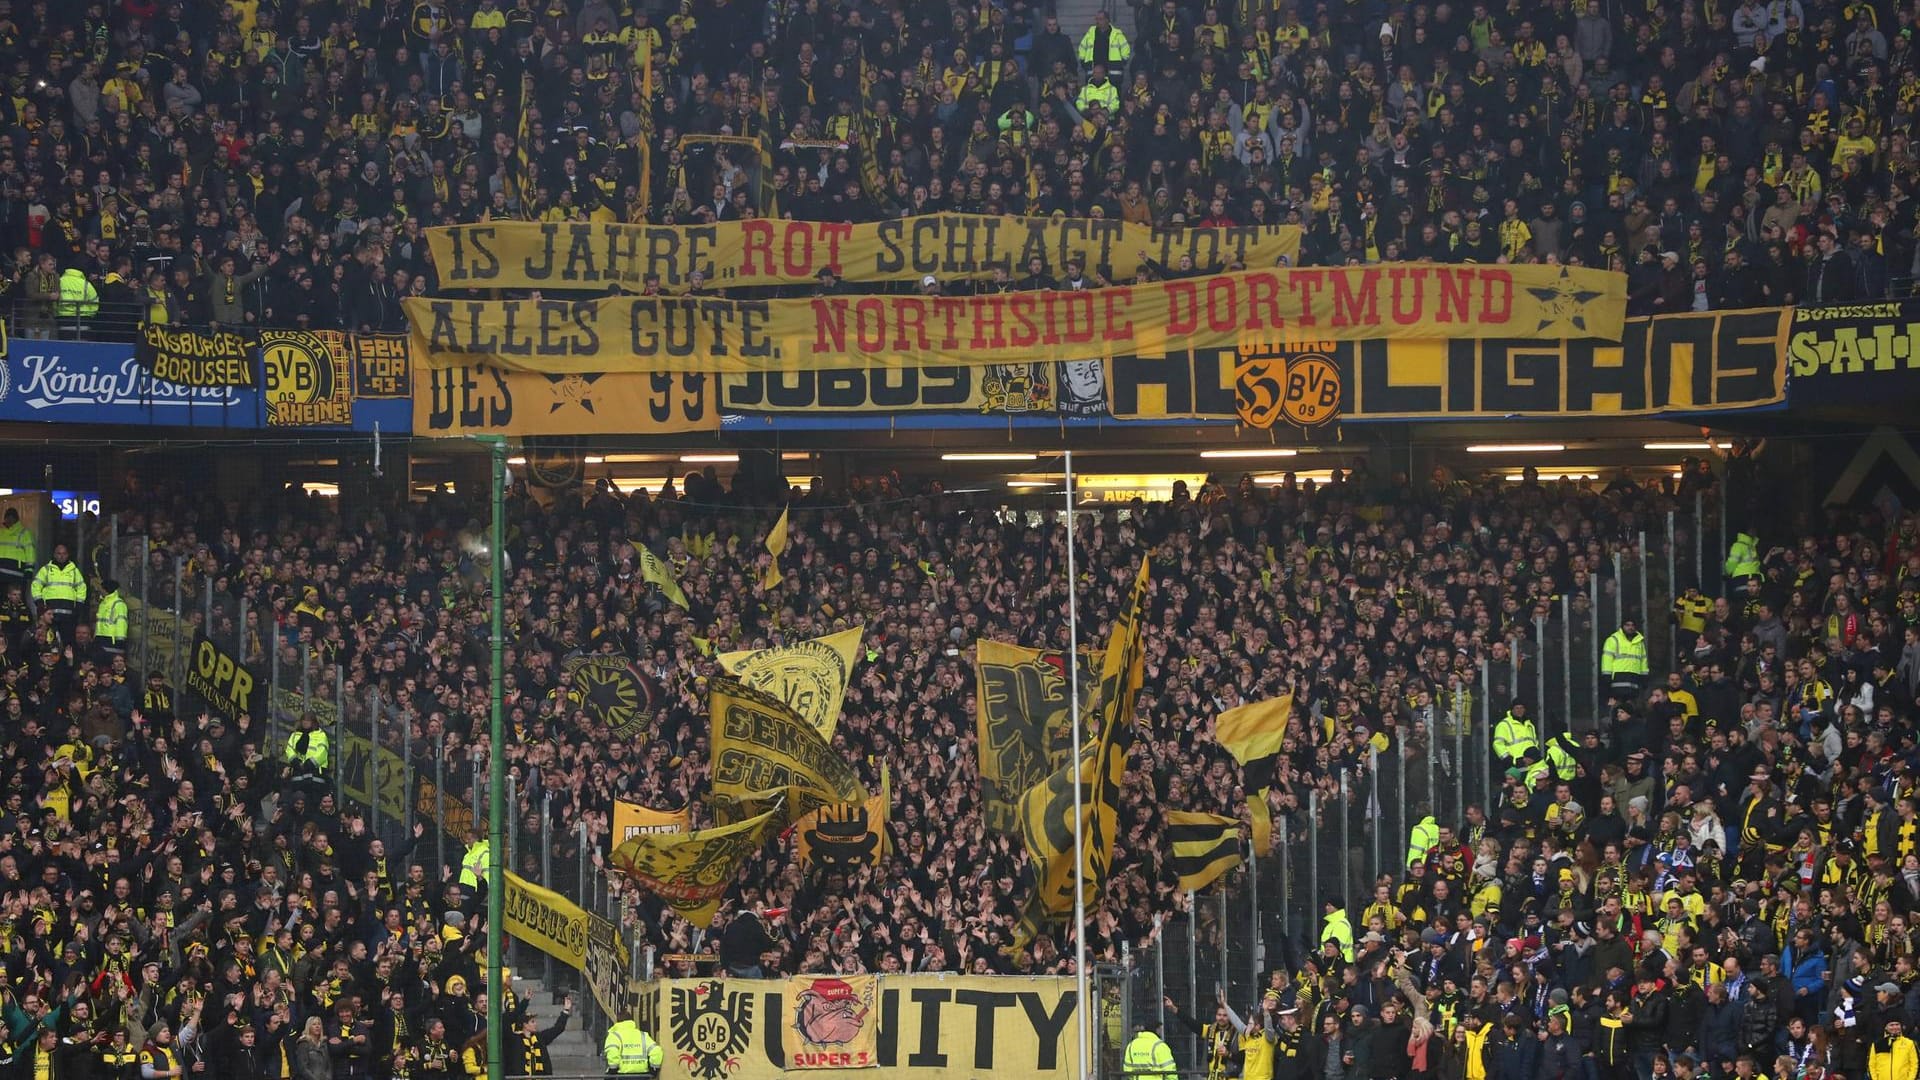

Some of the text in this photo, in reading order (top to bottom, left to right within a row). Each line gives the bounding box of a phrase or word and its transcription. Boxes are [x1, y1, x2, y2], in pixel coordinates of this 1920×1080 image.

[525, 223, 716, 285] JAHRE
[428, 300, 600, 356] ALLES
[811, 285, 1134, 354] NORTHSIDE
[1164, 267, 1514, 336] DORTMUND
[1796, 303, 1902, 322] BORUSSEN
[18, 355, 119, 403] König
[154, 353, 251, 385] BORUSSEN
[265, 350, 313, 390] BVB
[361, 358, 405, 376] TOR
[1287, 364, 1338, 407] BVB
[277, 399, 351, 424] RHEINE!
[1298, 404, 1316, 417] 09
[1103, 490, 1171, 503] AUSGAN
[198, 640, 254, 713] OPR
[507, 887, 569, 948] LÜBECK
[697, 1017, 726, 1042] BVB
[705, 1042, 716, 1050] 09
[794, 1051, 869, 1066] SUPER 3
